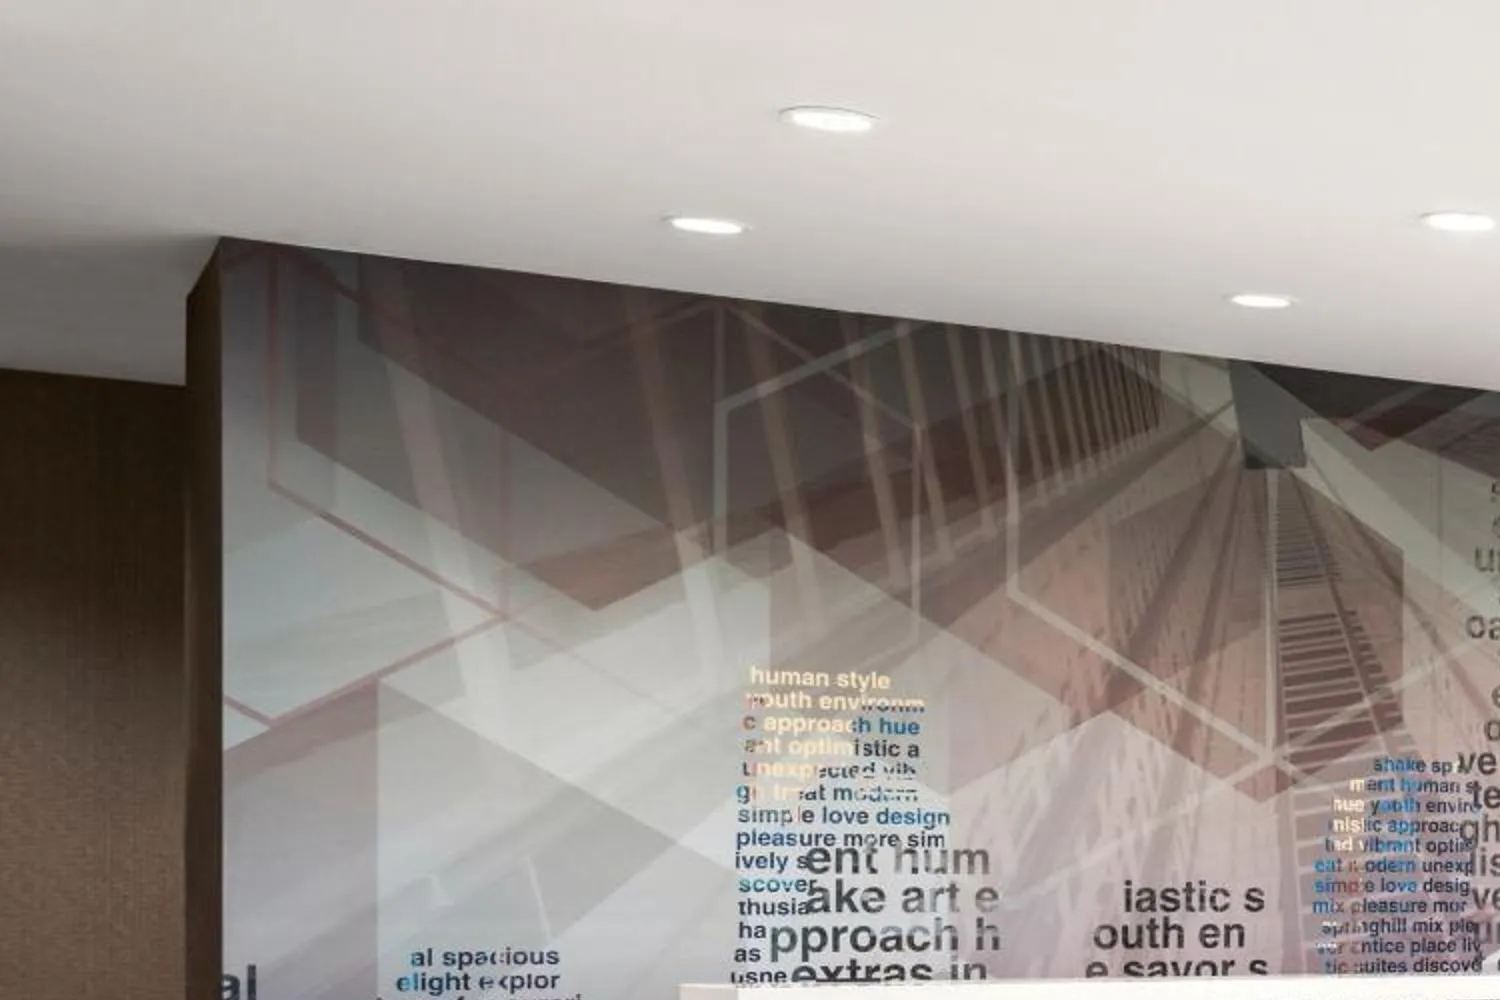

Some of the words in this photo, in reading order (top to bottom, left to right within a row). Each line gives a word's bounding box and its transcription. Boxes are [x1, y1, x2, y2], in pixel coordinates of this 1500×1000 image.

[750, 665, 830, 688] human
[837, 670, 892, 694] style
[763, 714, 872, 735] approach
[879, 716, 921, 735] hue
[788, 738, 901, 759] optimistic
[907, 743, 921, 759] a
[1400, 777, 1461, 794] human
[737, 805, 815, 826] simple
[822, 806, 869, 825] love
[875, 807, 951, 831] design
[736, 829, 836, 850] pleasure
[843, 832, 901, 848] more
[907, 831, 946, 848] sim
[735, 851, 789, 874] ively
[806, 843, 879, 875] ent
[738, 878, 817, 895] scover
[807, 878, 887, 914] ake
[901, 881, 961, 913] art
[974, 886, 999, 914] e
[1123, 879, 1231, 913] iastic
[1243, 886, 1266, 913] s
[1423, 877, 1470, 896] desig
[1092, 916, 1185, 950] outh
[1198, 921, 1246, 949] en
[1412, 917, 1443, 933] mix
[738, 921, 767, 939] ha
[770, 916, 959, 962] pproach
[975, 916, 1000, 951] h
[1410, 939, 1457, 957] place
[409, 947, 433, 967] al
[442, 946, 560, 971] spacious
[734, 946, 762, 963] as
[395, 972, 471, 996] elight
